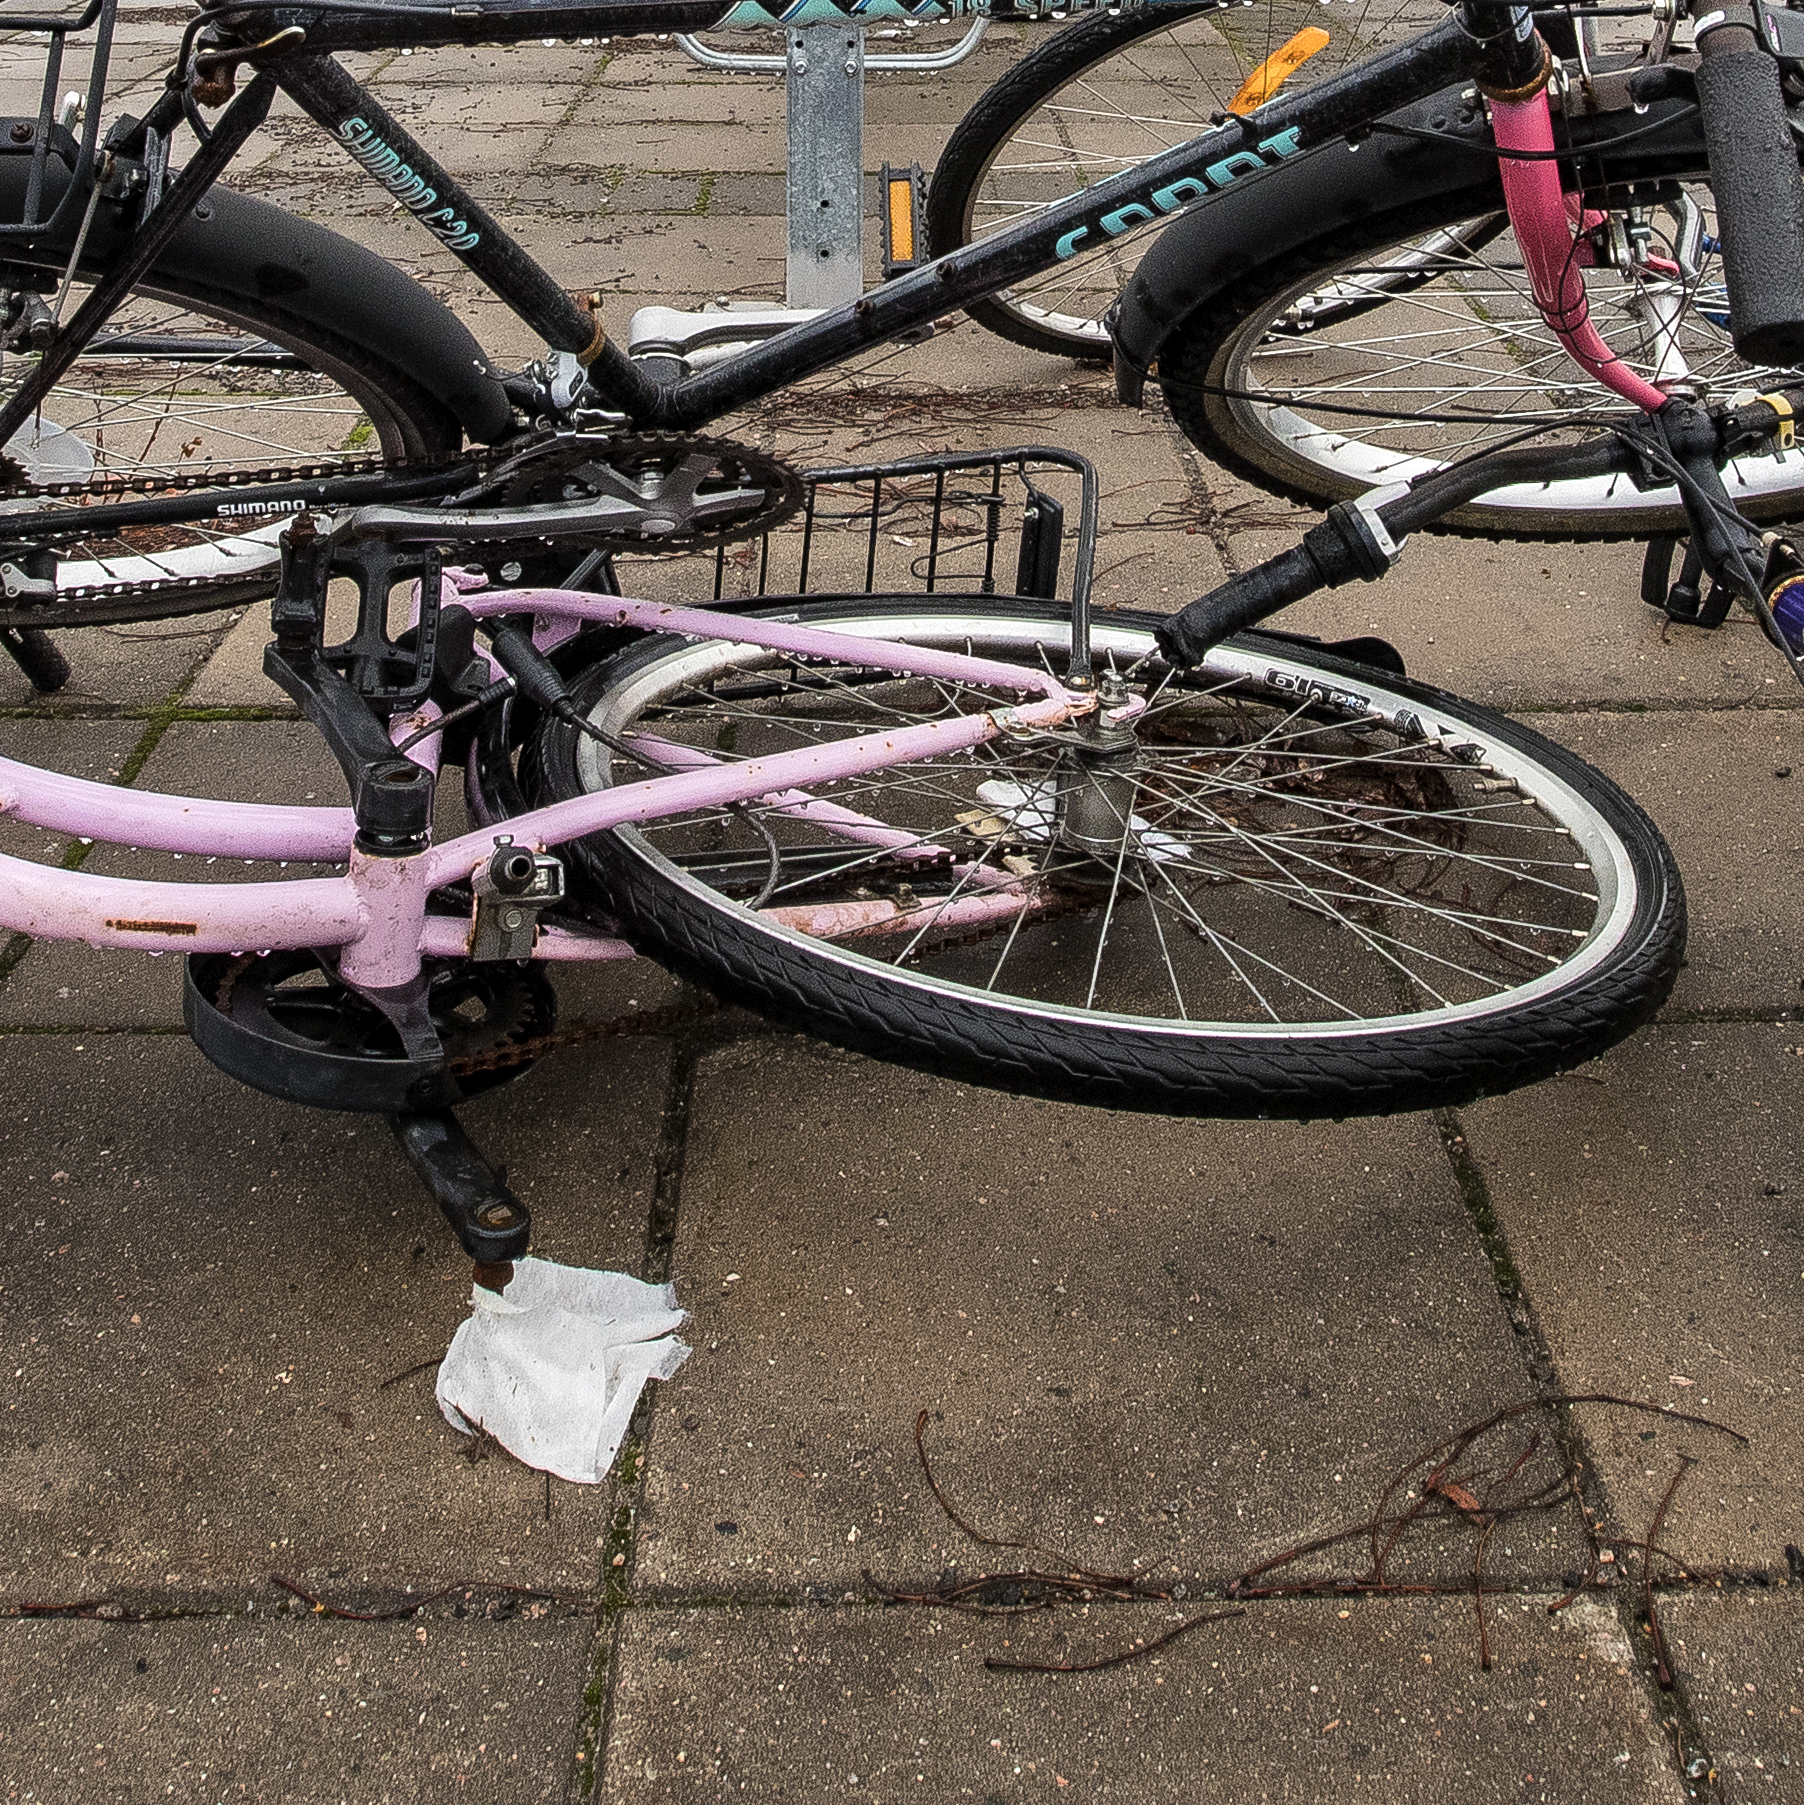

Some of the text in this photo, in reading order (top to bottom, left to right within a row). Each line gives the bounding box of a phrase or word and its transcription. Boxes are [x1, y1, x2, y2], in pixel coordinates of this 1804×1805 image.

[339, 117, 480, 251] SHIMANO C20
[217, 499, 307, 517] SHIMANO
